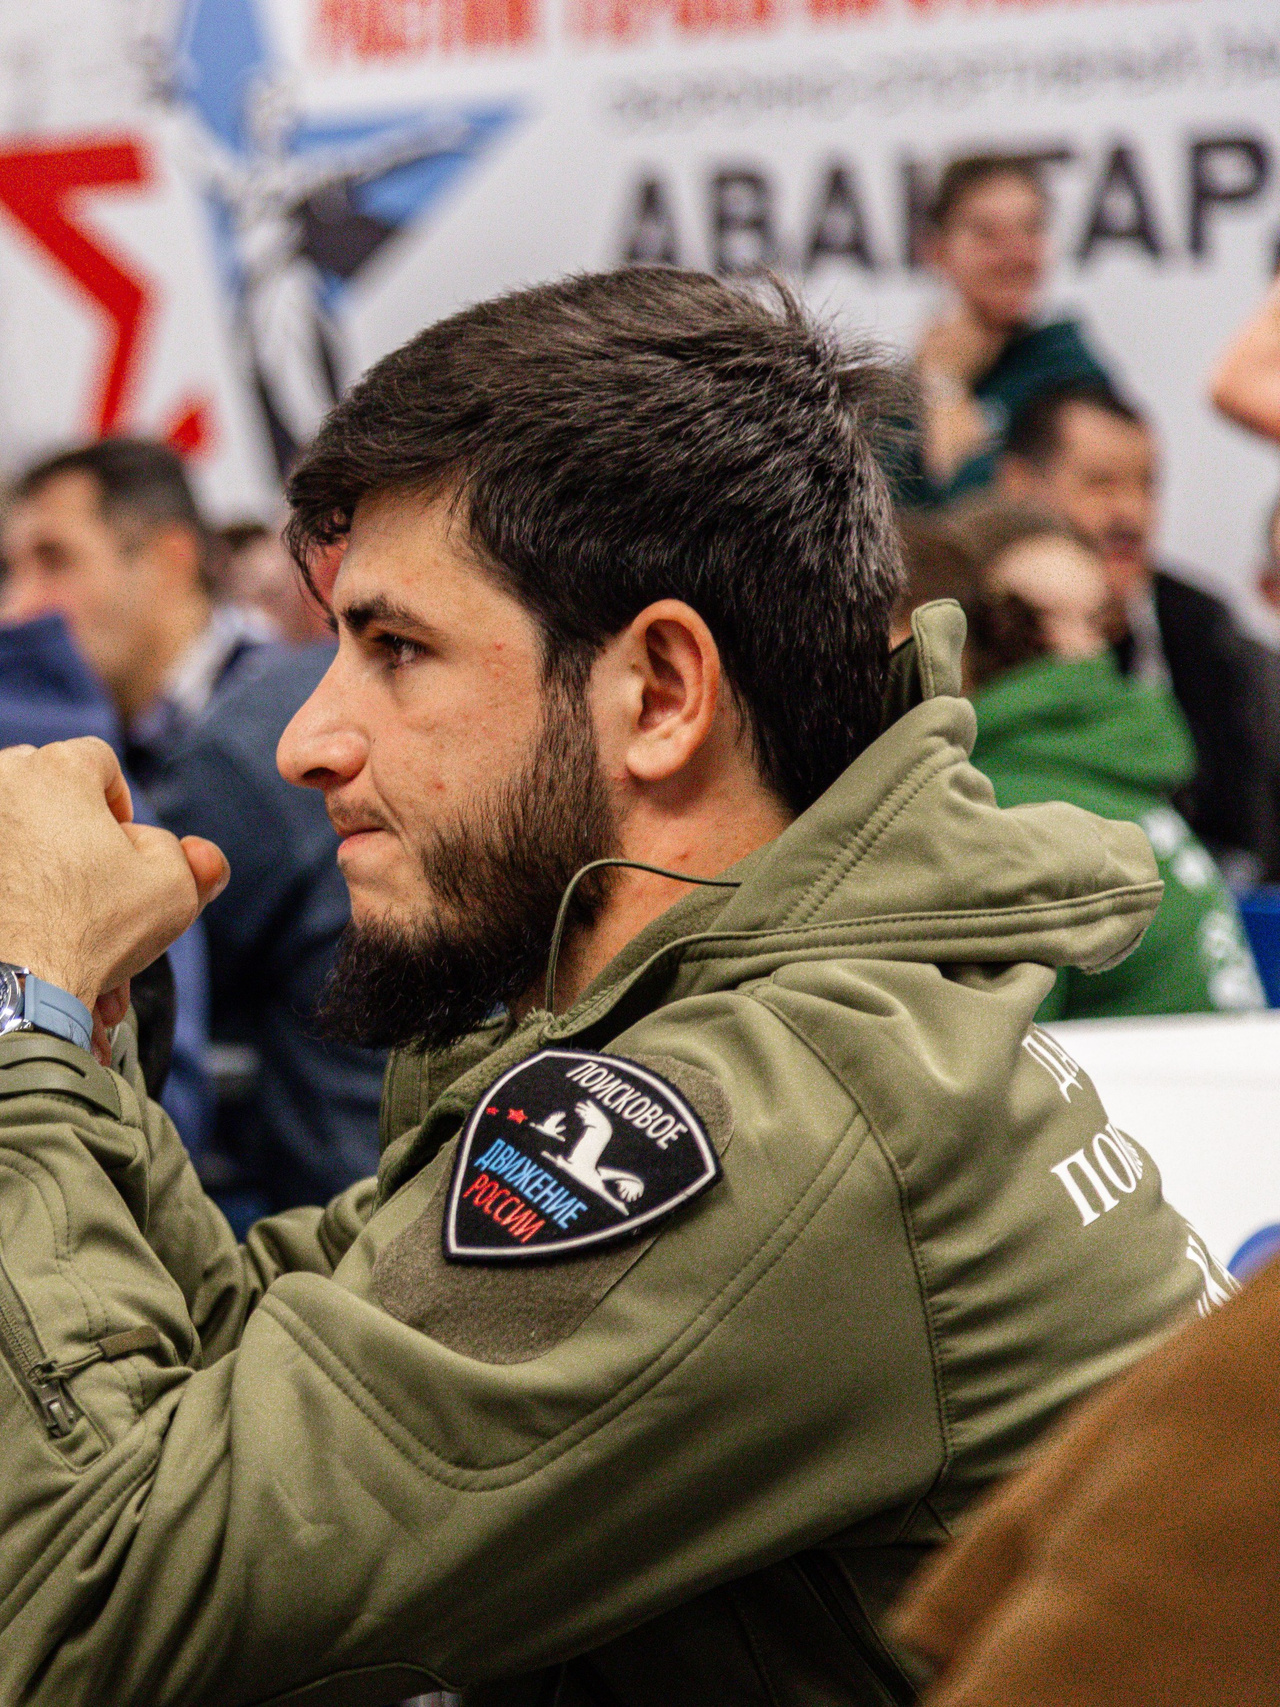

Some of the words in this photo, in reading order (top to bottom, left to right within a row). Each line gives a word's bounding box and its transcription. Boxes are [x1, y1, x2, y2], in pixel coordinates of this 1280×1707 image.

[566, 1061, 689, 1150] ПОИСКОВОЕ
[462, 1174, 546, 1244] РОССИИ
[473, 1138, 588, 1230] ДВИЖЕНИЕ
